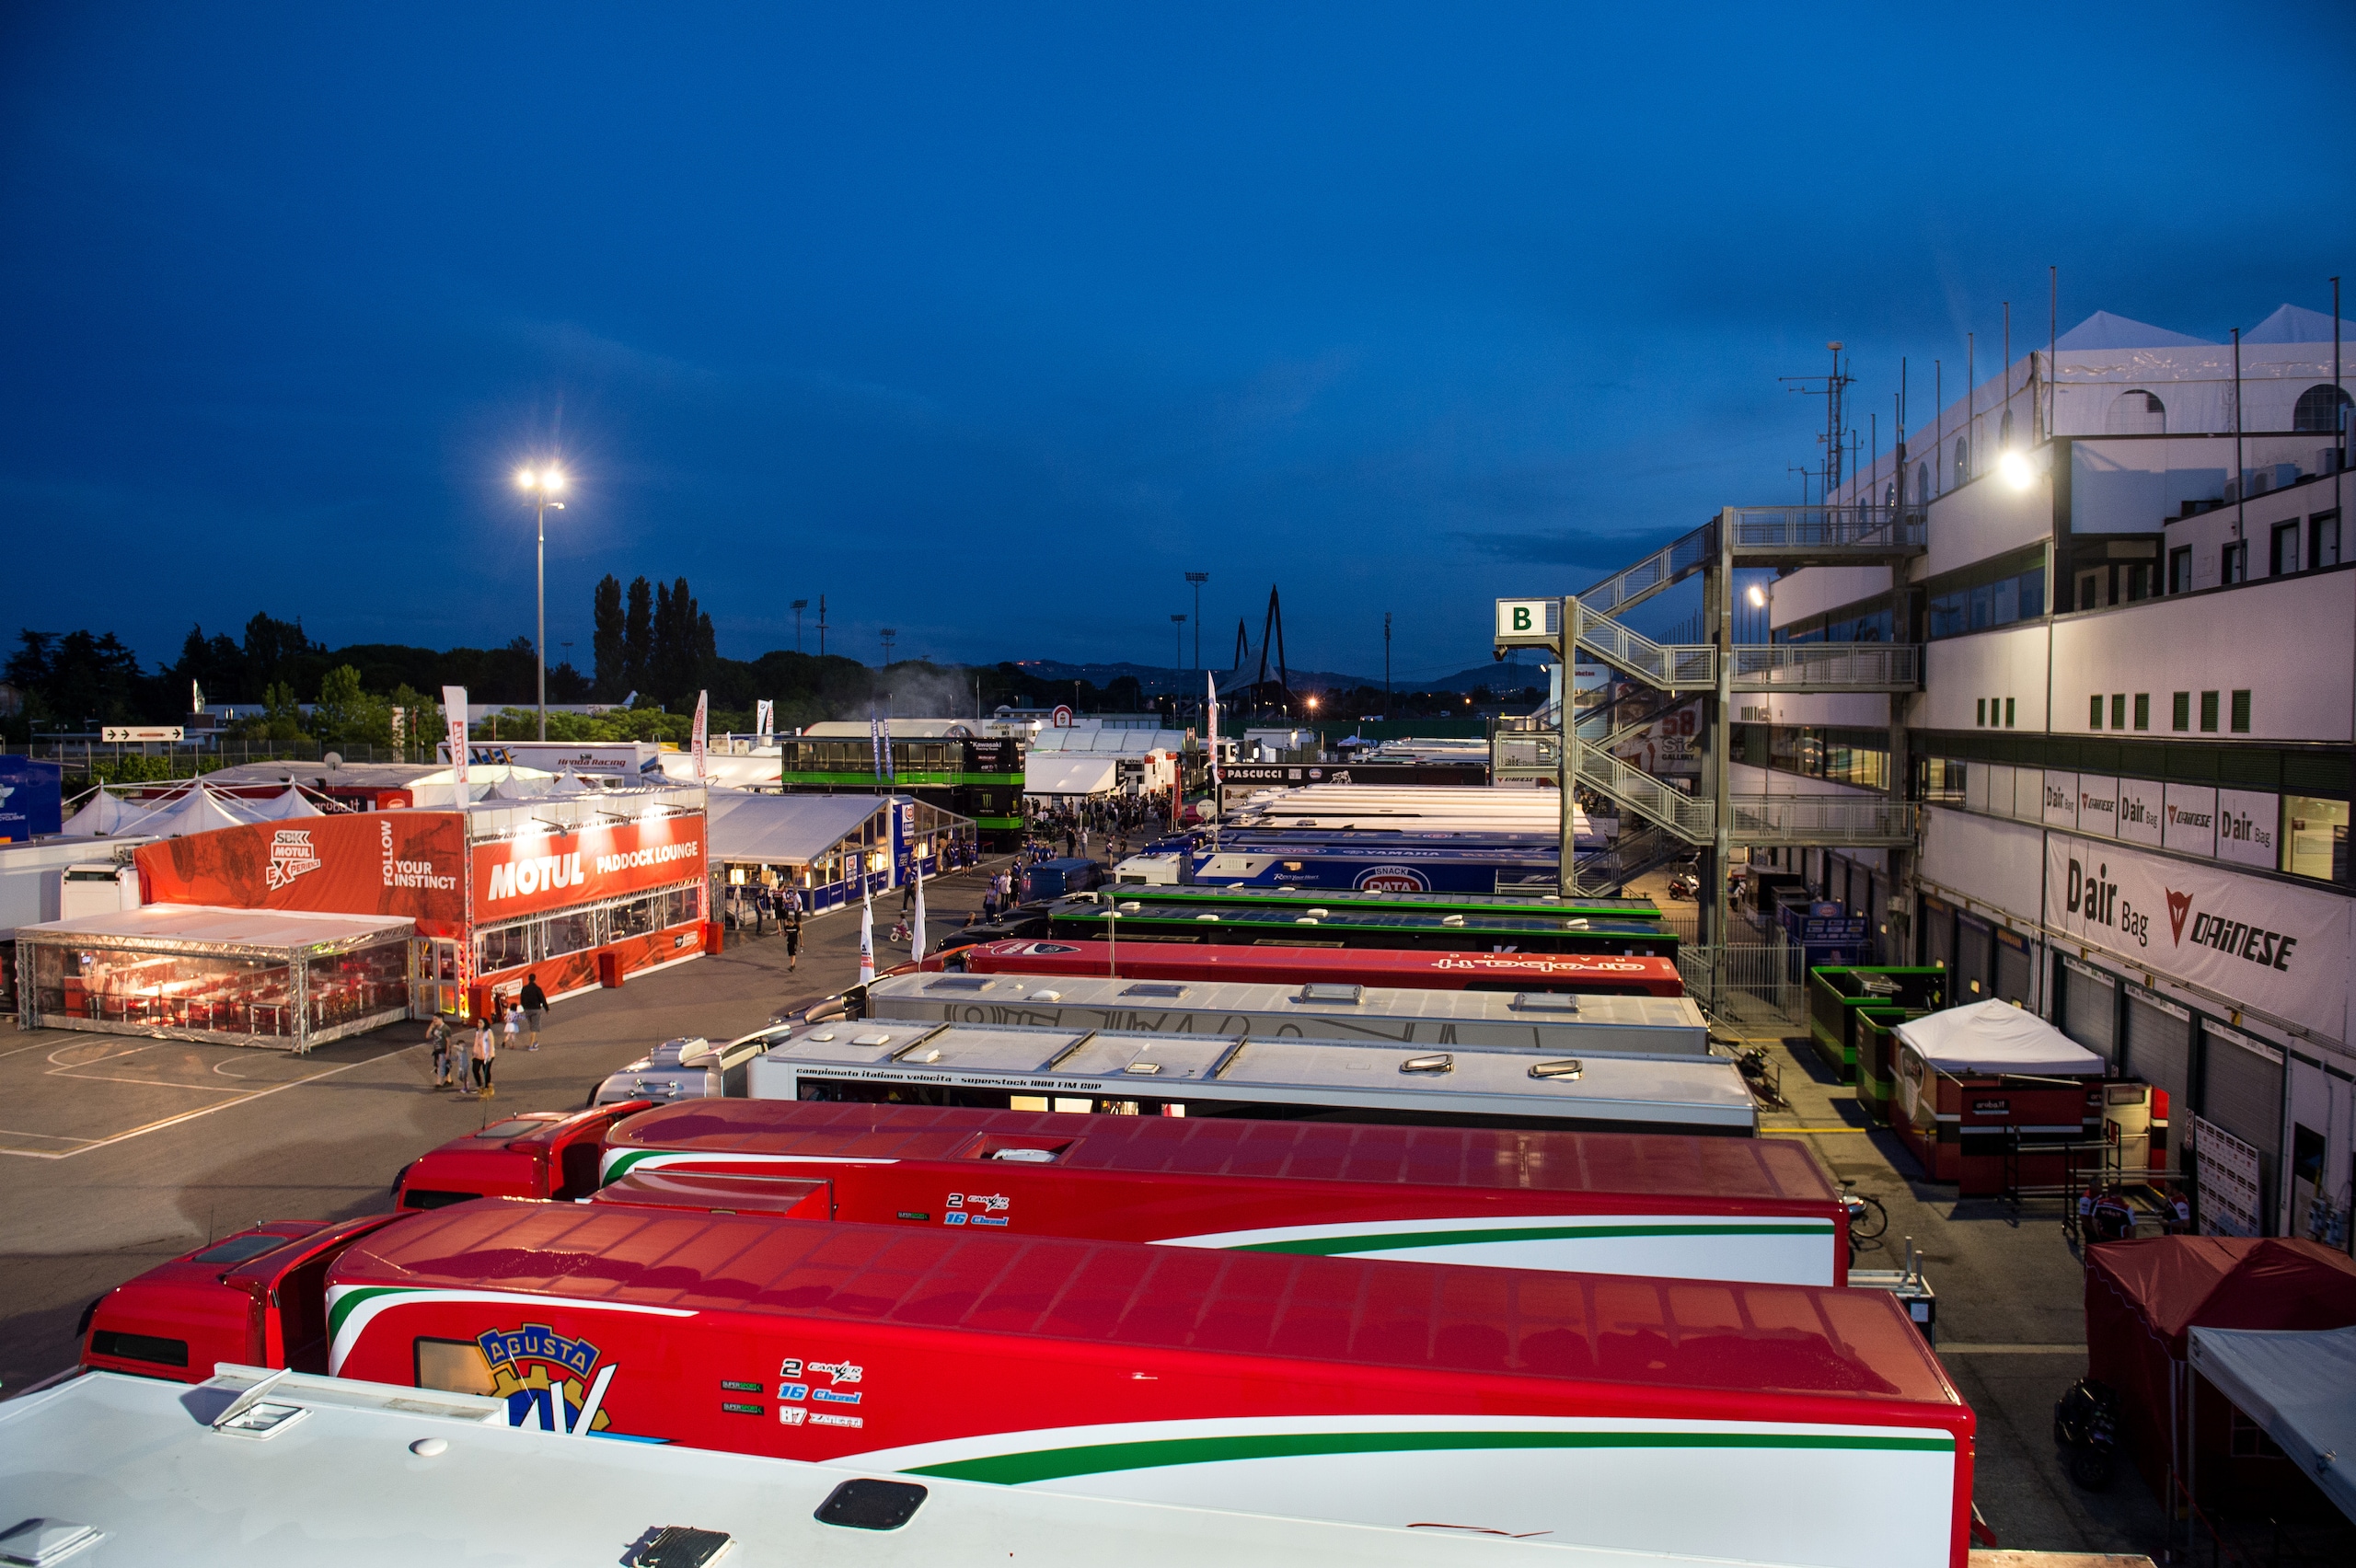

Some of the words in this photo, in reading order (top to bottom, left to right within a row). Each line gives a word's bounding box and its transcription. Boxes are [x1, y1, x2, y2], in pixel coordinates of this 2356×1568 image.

[1513, 606, 1532, 630] B
[1661, 737, 1694, 753] Sic
[1227, 769, 1282, 778] PASCUCCI
[277, 832, 302, 844] SBK
[2255, 827, 2270, 848] Bag
[274, 846, 311, 858] MOTUL
[380, 820, 394, 886] FOLLOW
[596, 847, 655, 874] PADDOCK
[655, 841, 699, 864] LOUNGE
[395, 860, 433, 874] YOUR
[487, 851, 584, 901] MOTUL
[394, 873, 456, 891] INSTINCT
[2121, 900, 2149, 948] Bag
[2189, 911, 2298, 972] DAINESE
[796, 1067, 859, 1077] campionato
[861, 1070, 904, 1079] italiano
[961, 1078, 1028, 1087] superstock
[947, 1194, 963, 1206] 2
[945, 1213, 966, 1224] 16
[490, 1335, 587, 1371] AGUSTA
[782, 1360, 802, 1377] 2
[780, 1385, 806, 1399] 16
[781, 1407, 806, 1424] 87
[812, 1413, 862, 1427] ZANETTI
